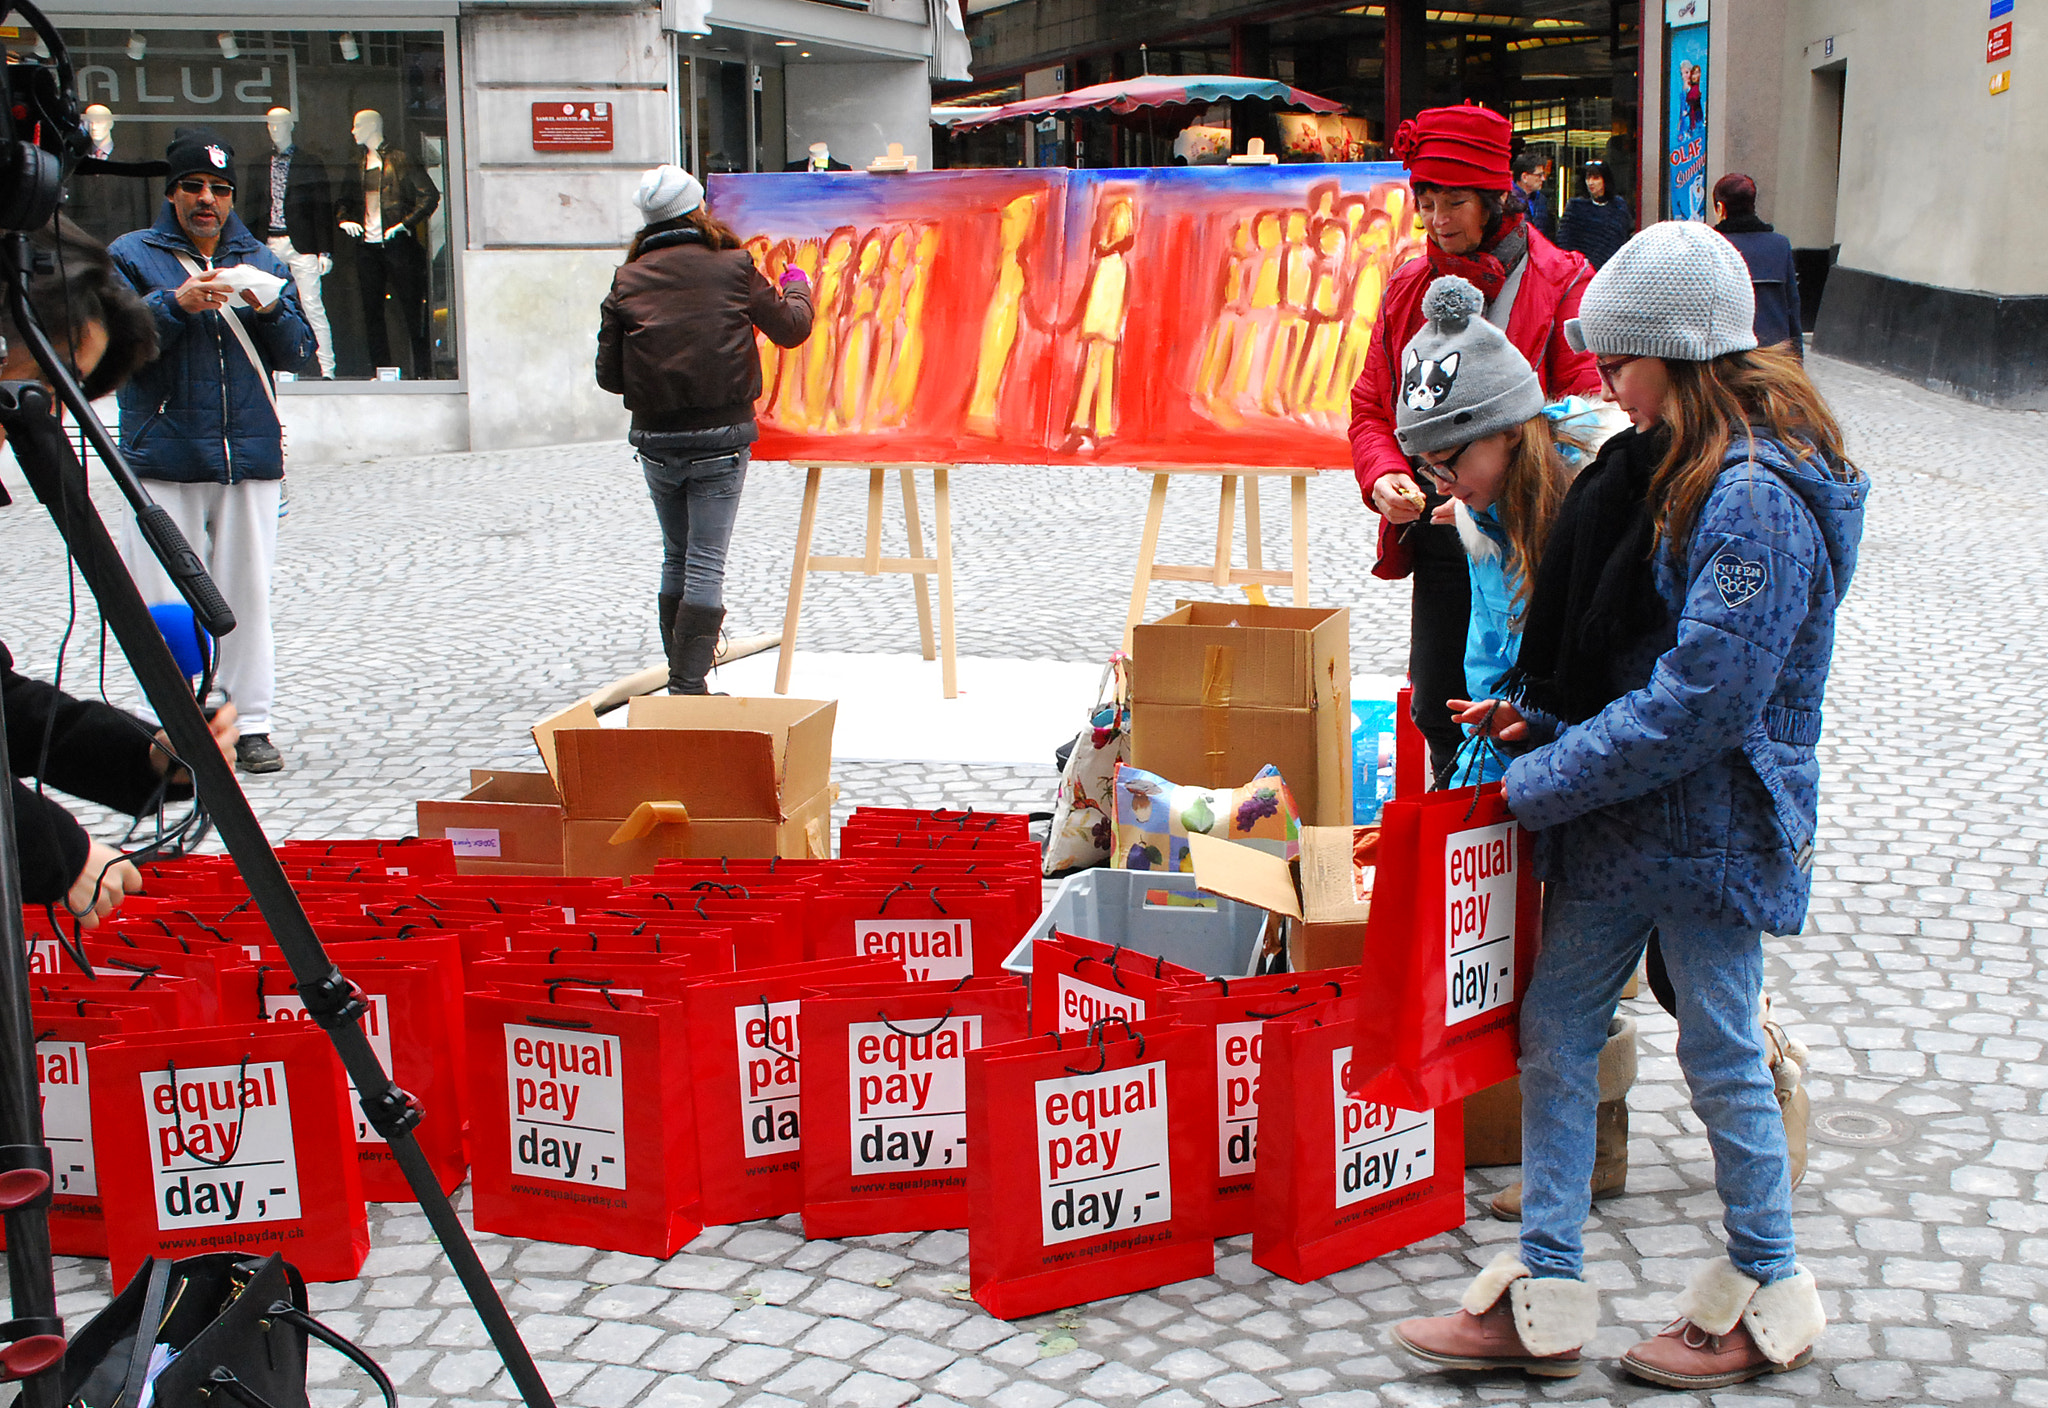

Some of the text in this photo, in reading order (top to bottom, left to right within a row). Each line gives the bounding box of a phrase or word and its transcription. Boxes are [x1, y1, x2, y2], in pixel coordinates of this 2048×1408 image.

[1670, 137, 1702, 166] OLAF
[1716, 563, 1761, 578] QUEEN
[1719, 574, 1758, 596] ROCK
[1450, 827, 1512, 892] equal
[1450, 891, 1491, 949] pay
[513, 1036, 613, 1079] equal
[857, 1020, 971, 1071] equal
[153, 1067, 277, 1121] equal
[749, 1055, 799, 1097] pa
[859, 1072, 933, 1115] pay
[516, 1077, 580, 1121] pay
[1045, 1067, 1157, 1130] equal
[158, 1121, 238, 1167] pay
[1048, 1128, 1122, 1180] pay
[511, 1183, 628, 1209] www.equalpayday.ch
[850, 1176, 967, 1193] www.equalpayday
[1334, 1185, 1434, 1226] www.equalpayday.ch
[158, 1227, 305, 1250] www.equalpayday.ch
[1042, 1229, 1173, 1265] www.equalpayday.ch
